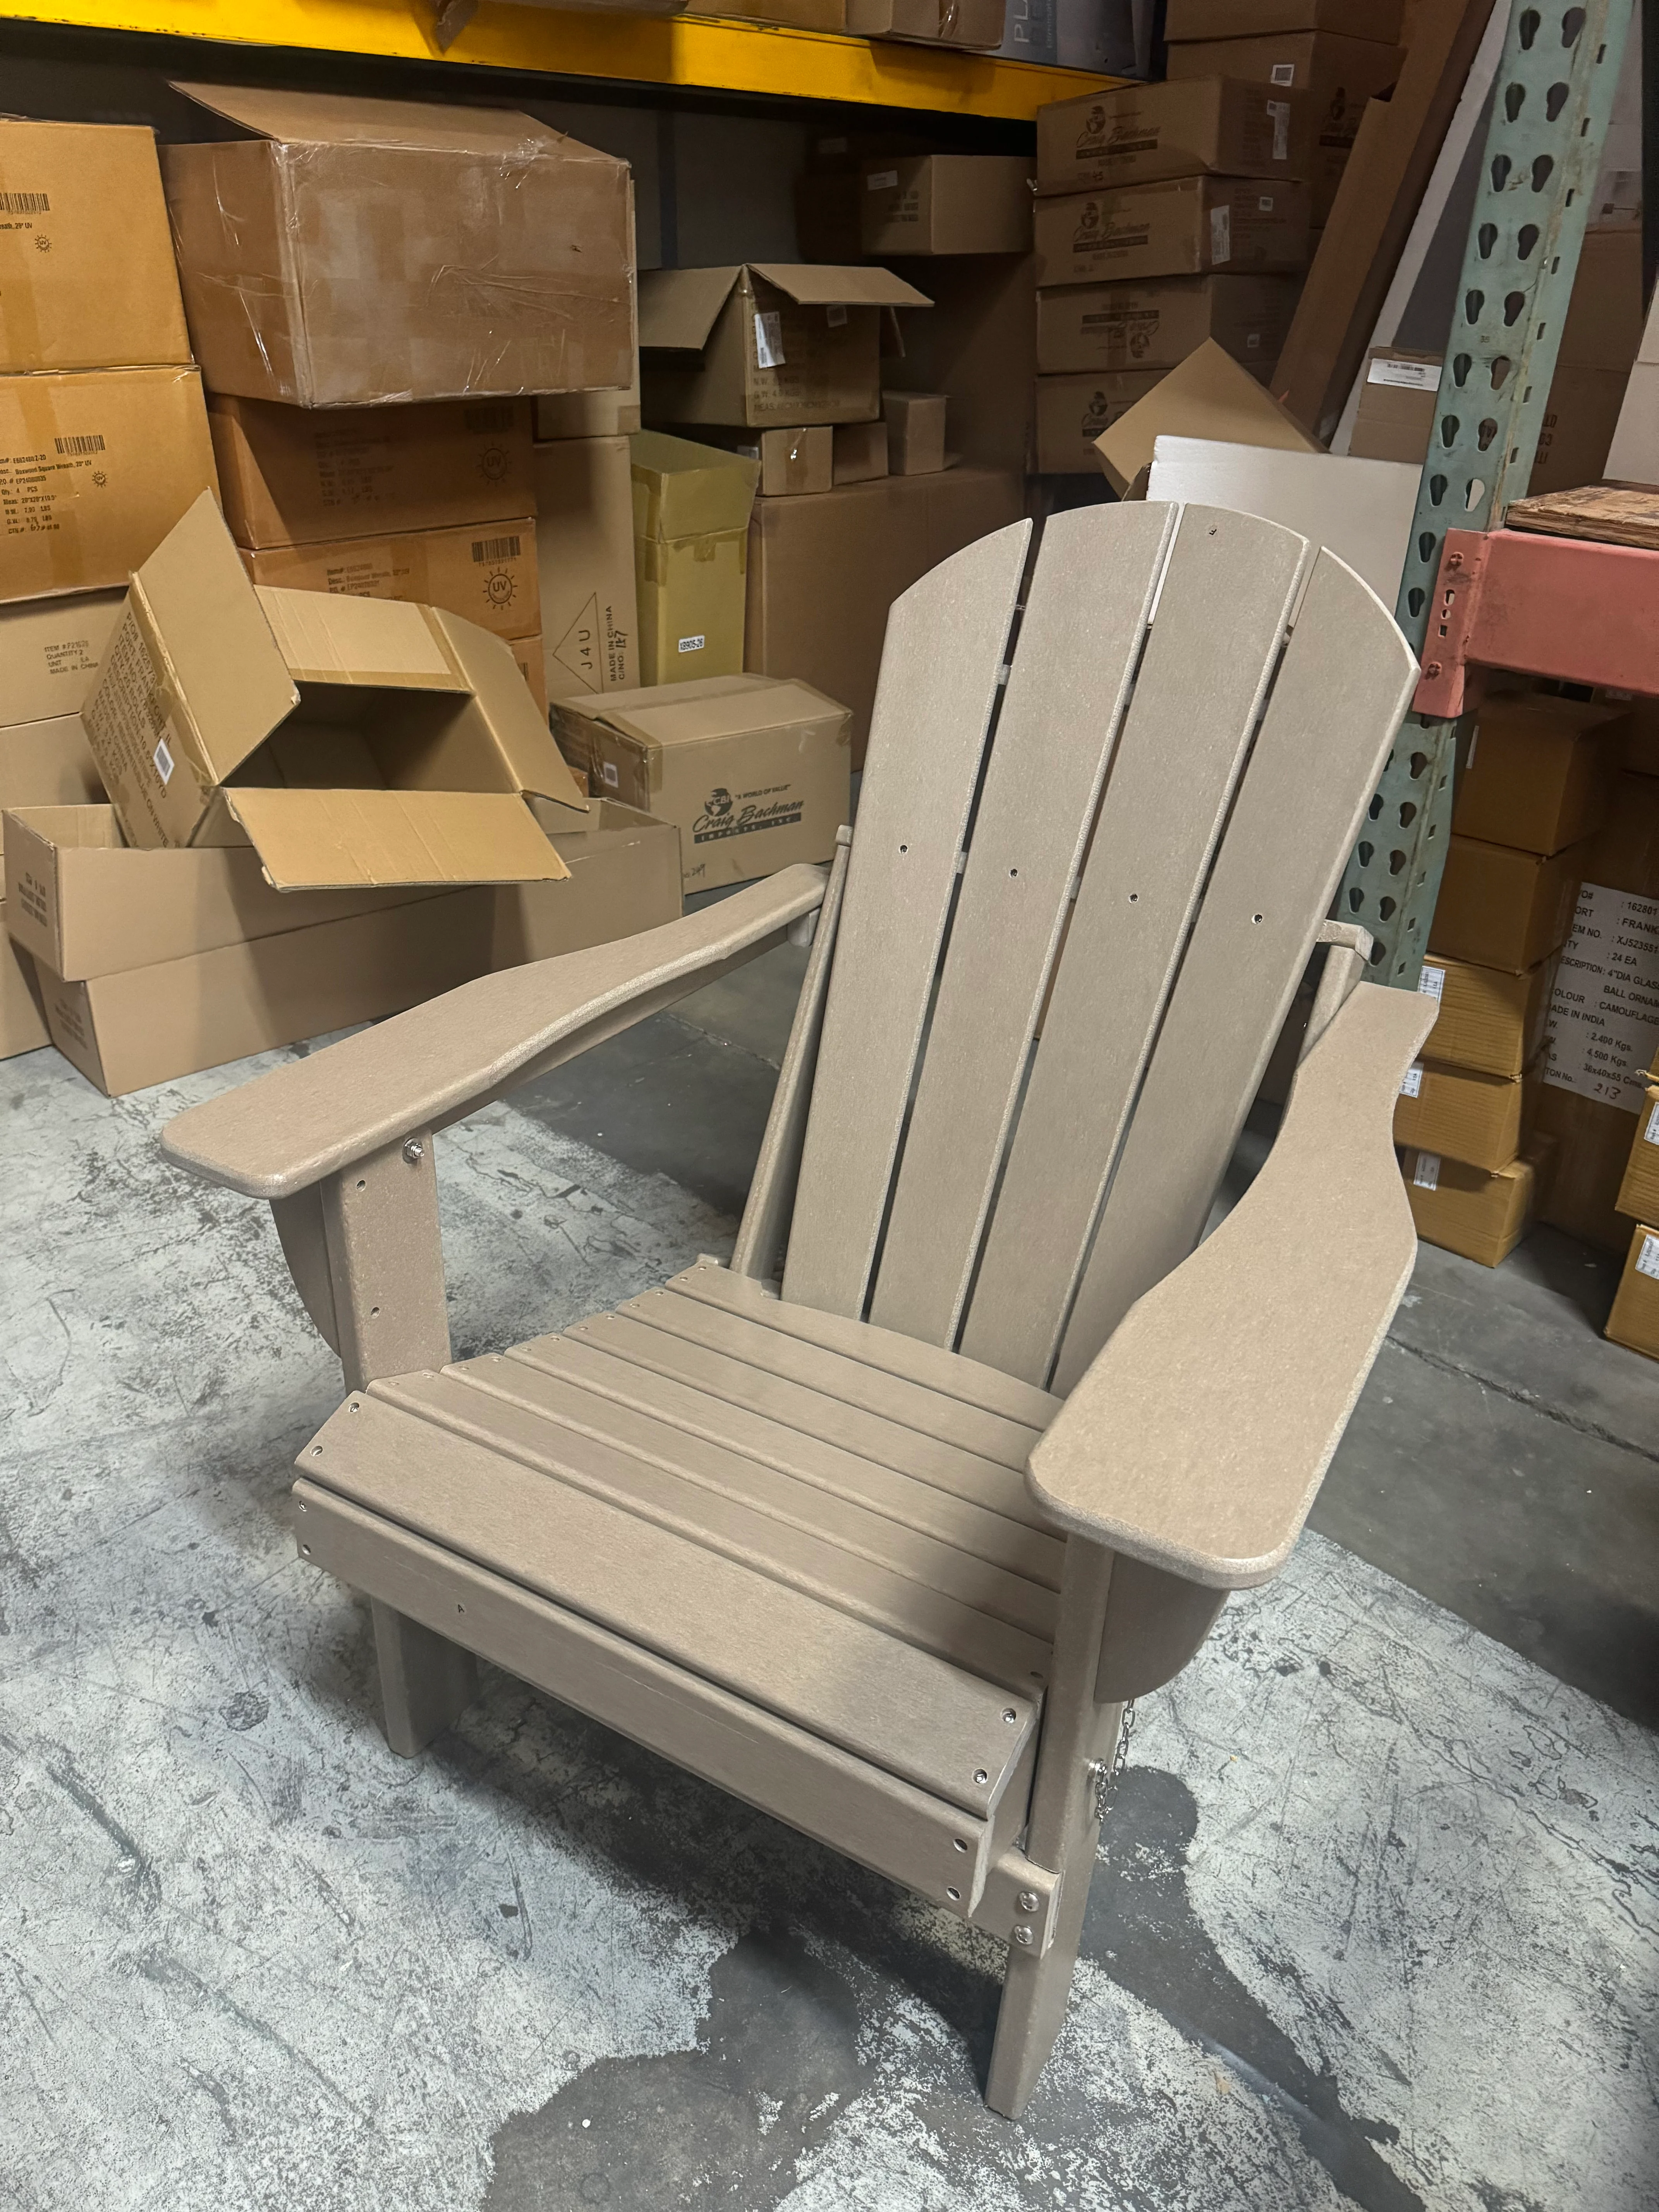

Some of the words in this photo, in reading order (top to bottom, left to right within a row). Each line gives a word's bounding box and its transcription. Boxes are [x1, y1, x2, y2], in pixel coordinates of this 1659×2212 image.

[493, 582, 507, 592] UV
[606, 606, 614, 638] CHINA
[608, 641, 615, 651] IN
[46, 650, 77, 659] QUANTITY
[50, 666, 69, 674] MADE
[743, 790, 763, 799] WORLD
[692, 812, 735, 833] Craig
[736, 800, 804, 826] Bachman
[1611, 952, 1622, 962] 24
[1624, 955, 1637, 966] EA
[1604, 985, 1626, 998] BALL
[1571, 1009, 1580, 1019] IN
[1582, 1013, 1605, 1027] INDIA
[1594, 1083, 1621, 1100] 213
